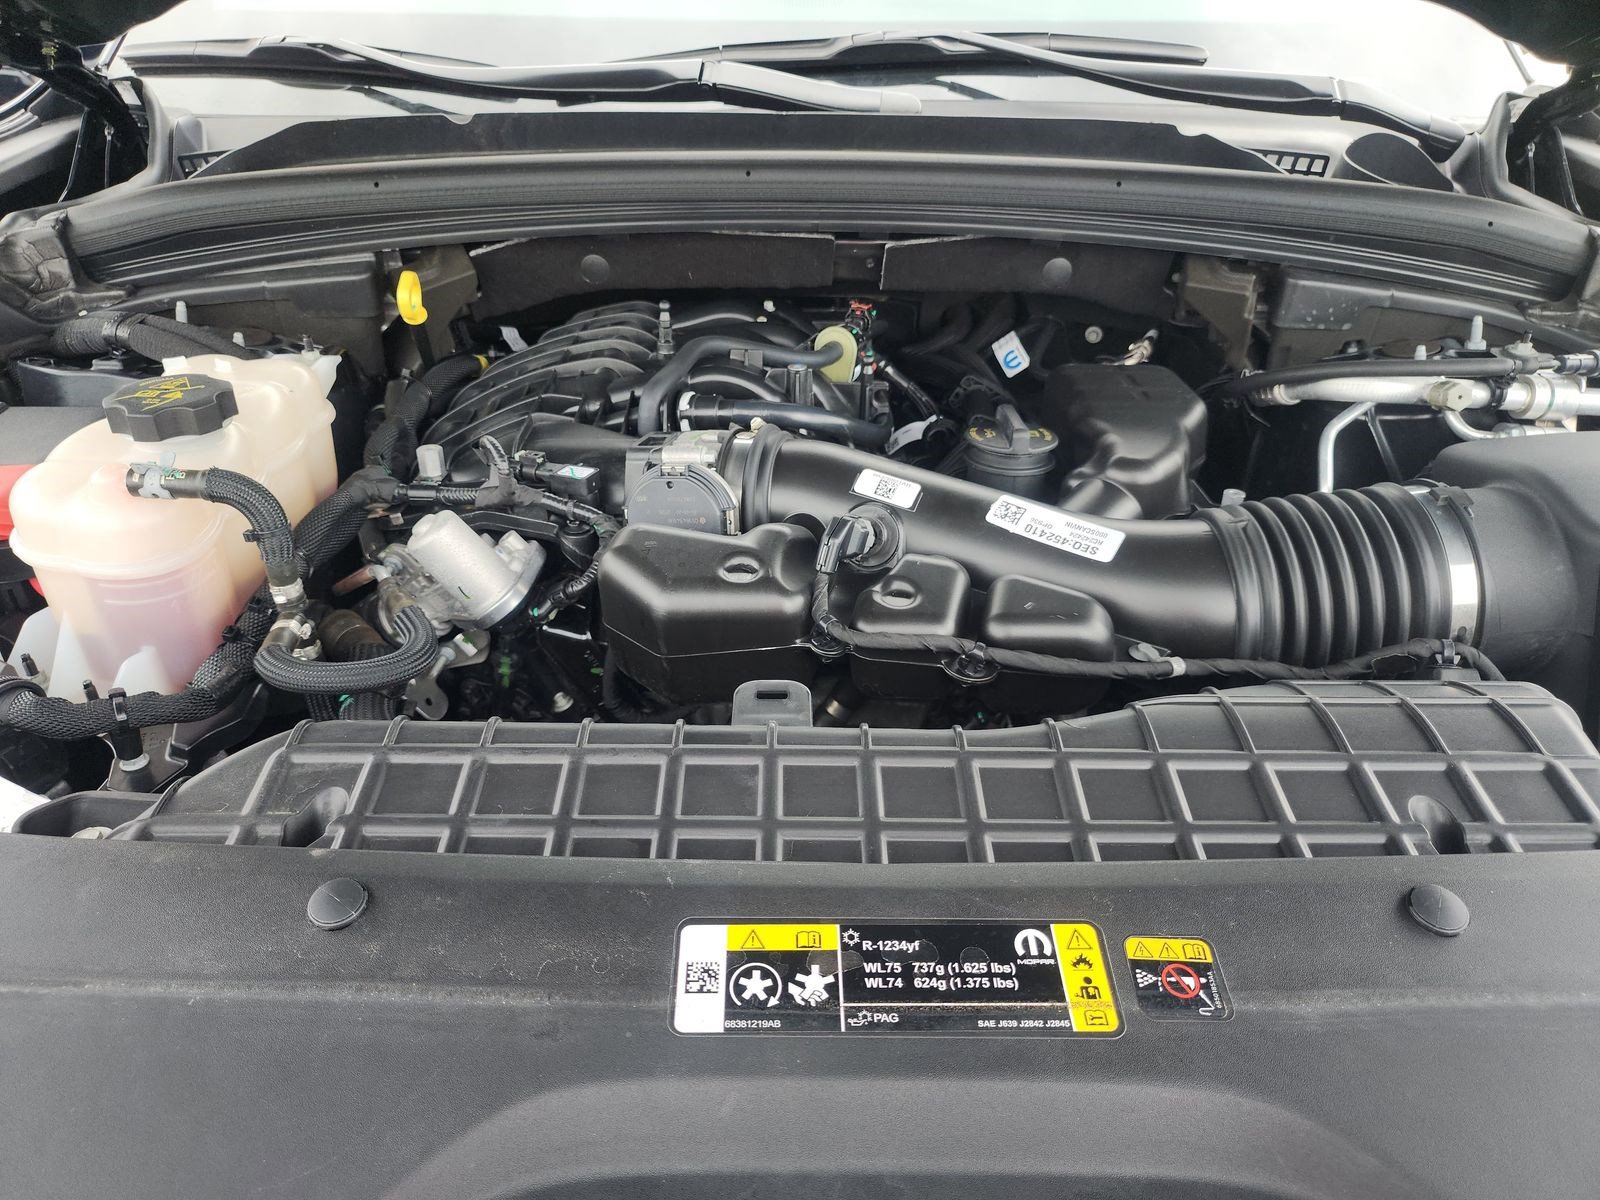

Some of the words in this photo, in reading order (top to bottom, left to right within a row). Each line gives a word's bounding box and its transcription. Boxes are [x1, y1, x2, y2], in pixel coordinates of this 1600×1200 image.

[862, 940, 921, 952] R-1234yf
[1017, 958, 1054, 966] MOPAR
[863, 962, 902, 974] WL75
[912, 962, 944, 976] 737g
[948, 962, 988, 976] (1.625
[990, 962, 1017, 976] lbs)
[865, 977, 903, 989] WL74
[914, 977, 946, 991] 624g
[950, 977, 990, 991] (1.375
[993, 977, 1020, 991] lbs)
[724, 1019, 782, 1029] 68381219AB
[873, 1013, 899, 1024] PAG
[977, 1019, 997, 1029] SAE
[998, 1019, 1018, 1029] J639
[1019, 1019, 1045, 1029] J2842
[1046, 1019, 1071, 1029] J2845
